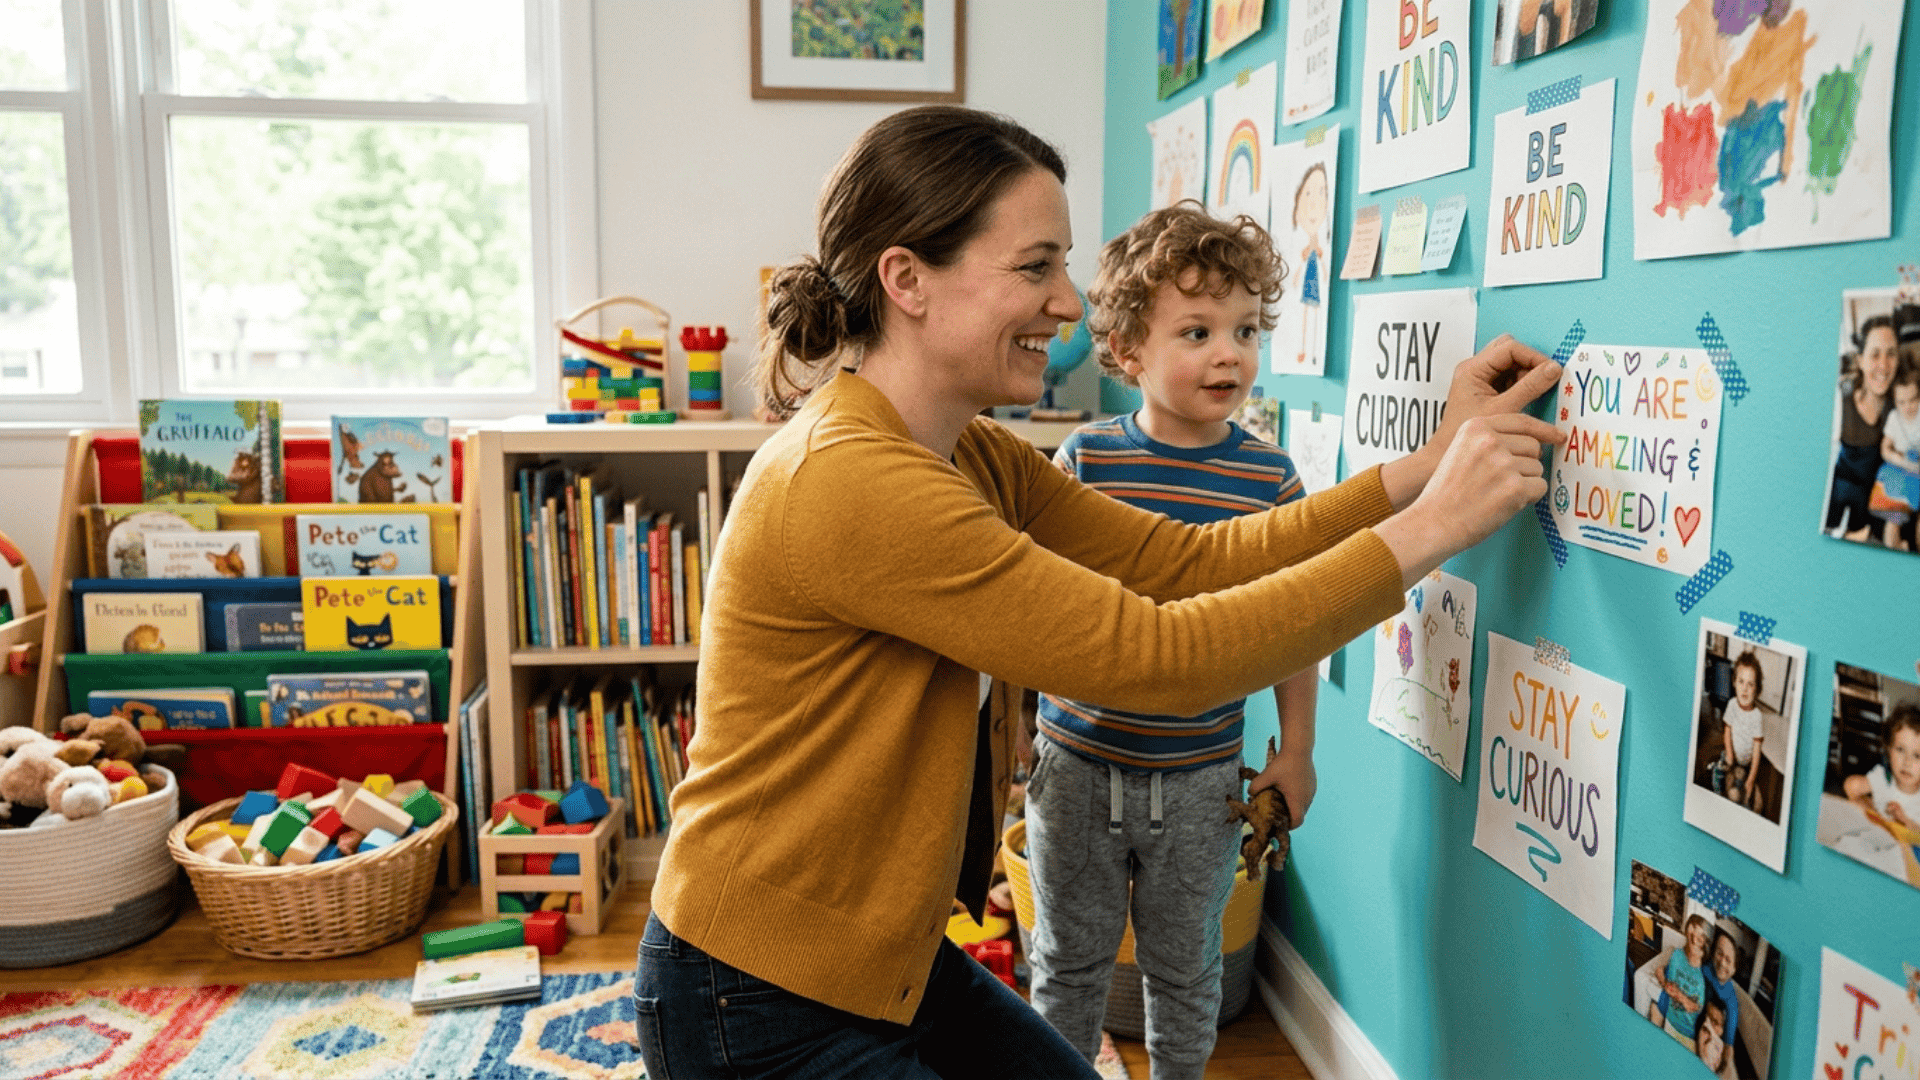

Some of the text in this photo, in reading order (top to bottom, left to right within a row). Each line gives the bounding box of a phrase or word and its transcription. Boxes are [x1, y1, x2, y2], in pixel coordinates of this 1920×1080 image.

[1399, 0, 1439, 50] BE
[1376, 40, 1459, 144] KIND
[1526, 122, 1568, 184] BE
[1501, 182, 1588, 255] KIND
[1376, 320, 1440, 382] STAY
[1356, 392, 1447, 453] CURIOU
[1575, 368, 1690, 420] YOU ARE
[157, 423, 245, 441] GRUFFALO
[1564, 425, 1701, 482] AMAZING &
[309, 523, 358, 545] Pete
[379, 524, 419, 544] Cat
[1573, 481, 1668, 537] LOVED!
[314, 585, 365, 608] Pete
[385, 585, 428, 606] Cat
[1509, 671, 1580, 759] STAY
[1489, 735, 1601, 858] CURIOUS
[1843, 983, 1920, 1080] Tri
